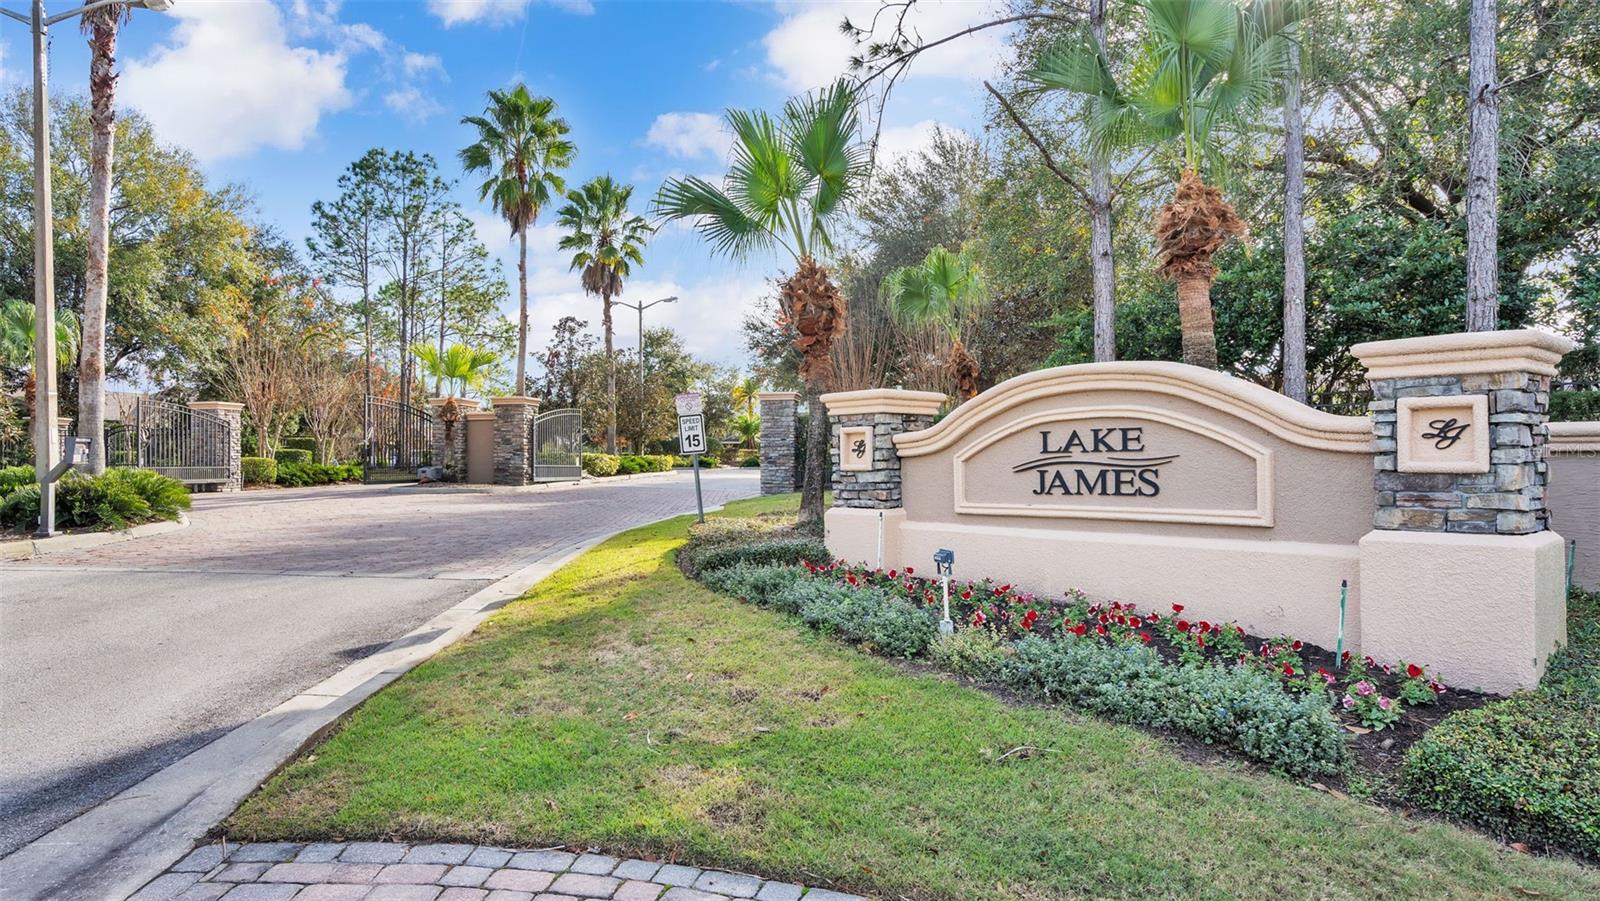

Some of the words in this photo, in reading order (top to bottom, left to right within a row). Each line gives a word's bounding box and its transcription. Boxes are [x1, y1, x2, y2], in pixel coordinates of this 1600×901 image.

[682, 417, 700, 425] SPEED
[685, 434, 701, 448] 15
[1039, 427, 1145, 454] LAKE
[1032, 468, 1161, 498] JAMES
